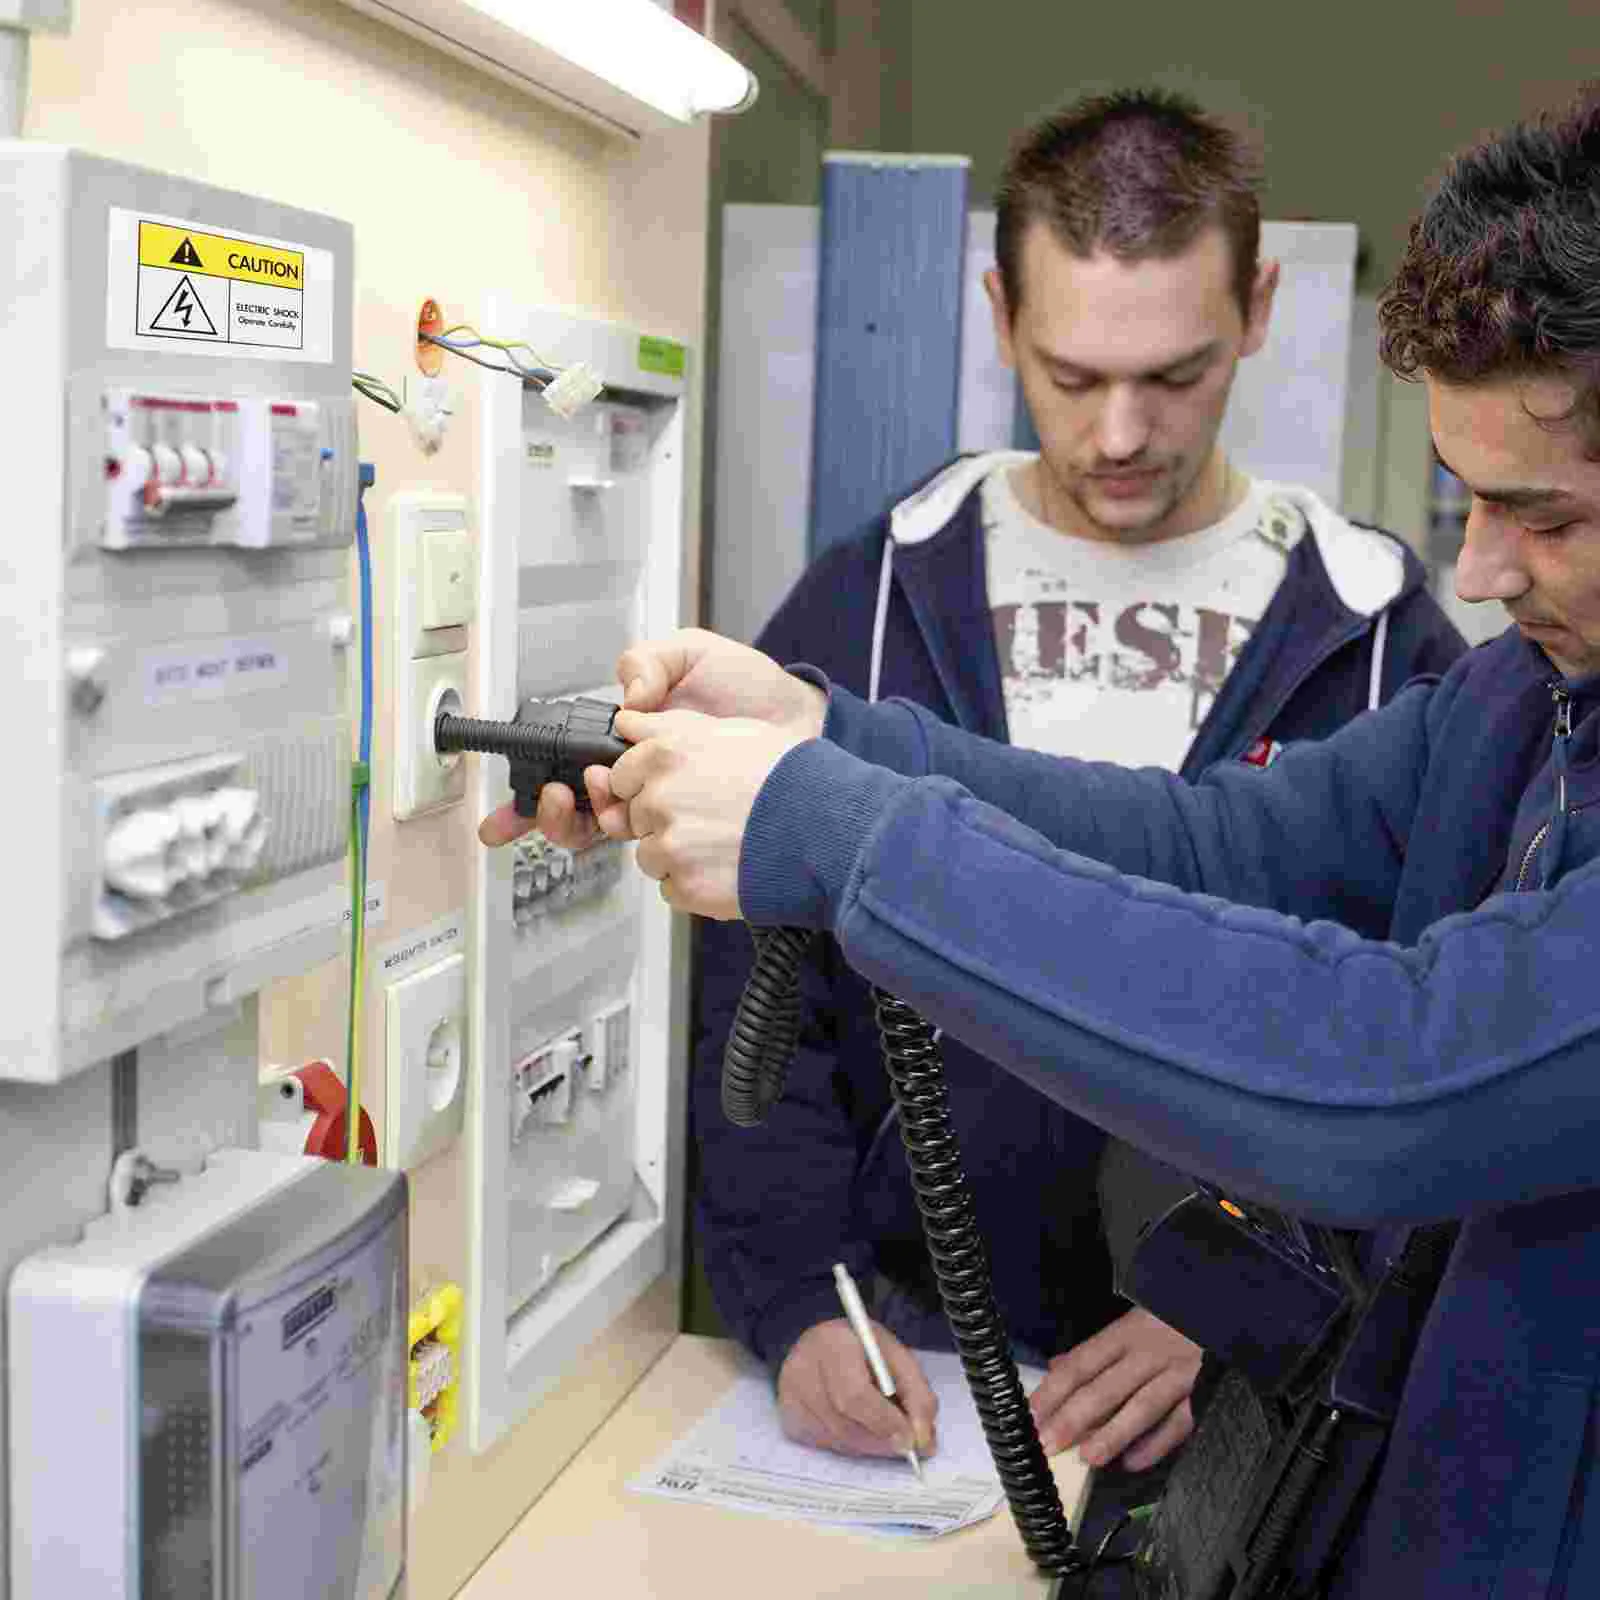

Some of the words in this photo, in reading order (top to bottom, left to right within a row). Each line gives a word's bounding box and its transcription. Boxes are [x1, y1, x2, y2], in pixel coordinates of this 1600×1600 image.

[228, 253, 299, 280] CAUTION
[236, 303, 271, 316] ELECTRIC
[273, 307, 300, 319] SHOCK
[238, 315, 266, 326] Operate
